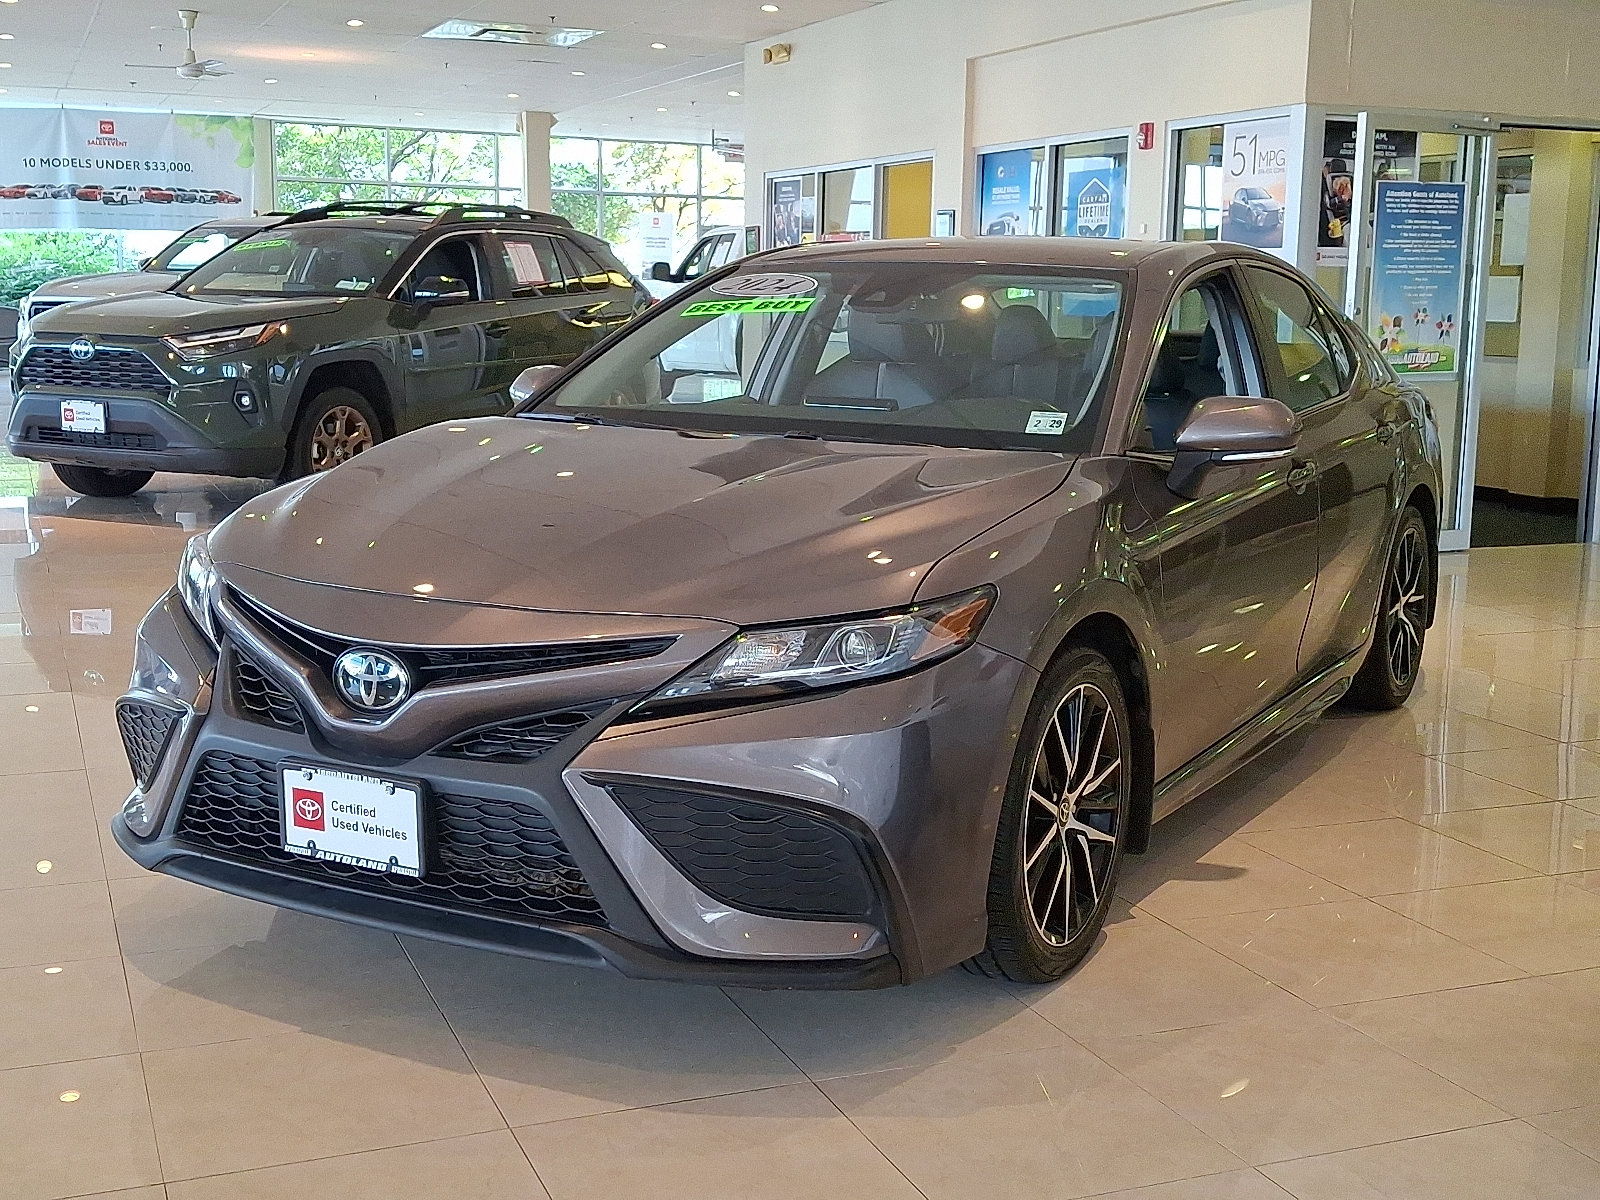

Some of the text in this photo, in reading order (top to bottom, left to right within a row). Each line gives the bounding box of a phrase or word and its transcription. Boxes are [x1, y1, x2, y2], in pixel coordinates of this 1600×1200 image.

[1230, 133, 1286, 176] 51 MPG
[22, 157, 194, 173] 10 MODELS UNDER $33,000.
[1078, 204, 1109, 218] LIFETIME
[685, 300, 811, 314] BEST BUY
[1034, 419, 1063, 429] 2 29
[331, 800, 376, 818] Certified
[331, 817, 408, 841] Used Vehicles
[315, 851, 388, 872] AUTOLAND
